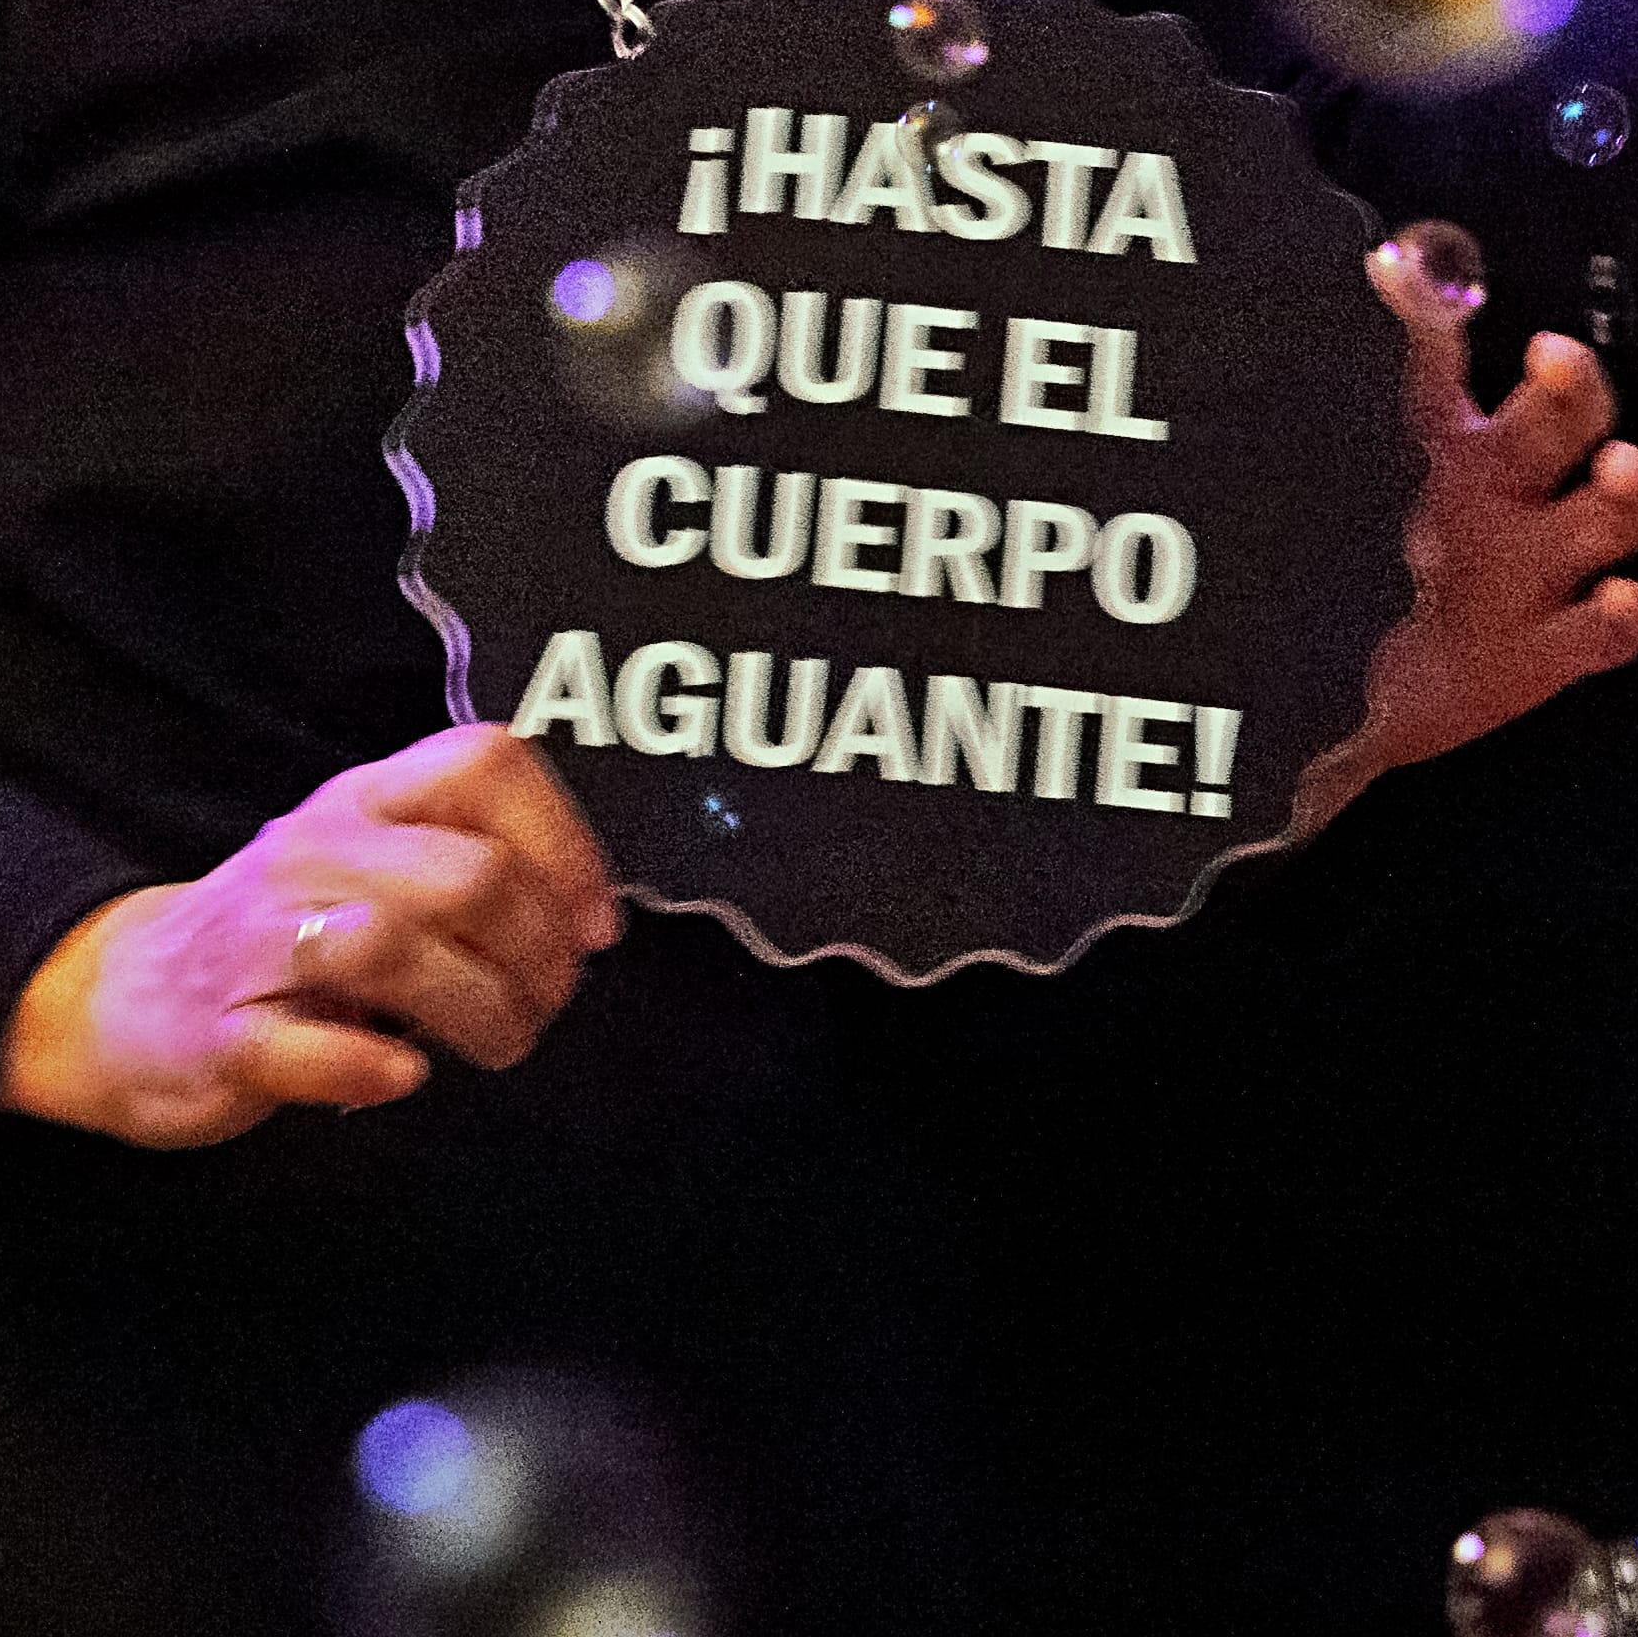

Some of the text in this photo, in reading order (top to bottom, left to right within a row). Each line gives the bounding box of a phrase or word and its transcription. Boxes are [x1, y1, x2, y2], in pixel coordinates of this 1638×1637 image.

[676, 107, 1198, 264] ¡HASTA
[671, 279, 1169, 442] QUE EL
[605, 455, 1197, 625] CUERPO
[512, 630, 1242, 819] AGUANTE!
